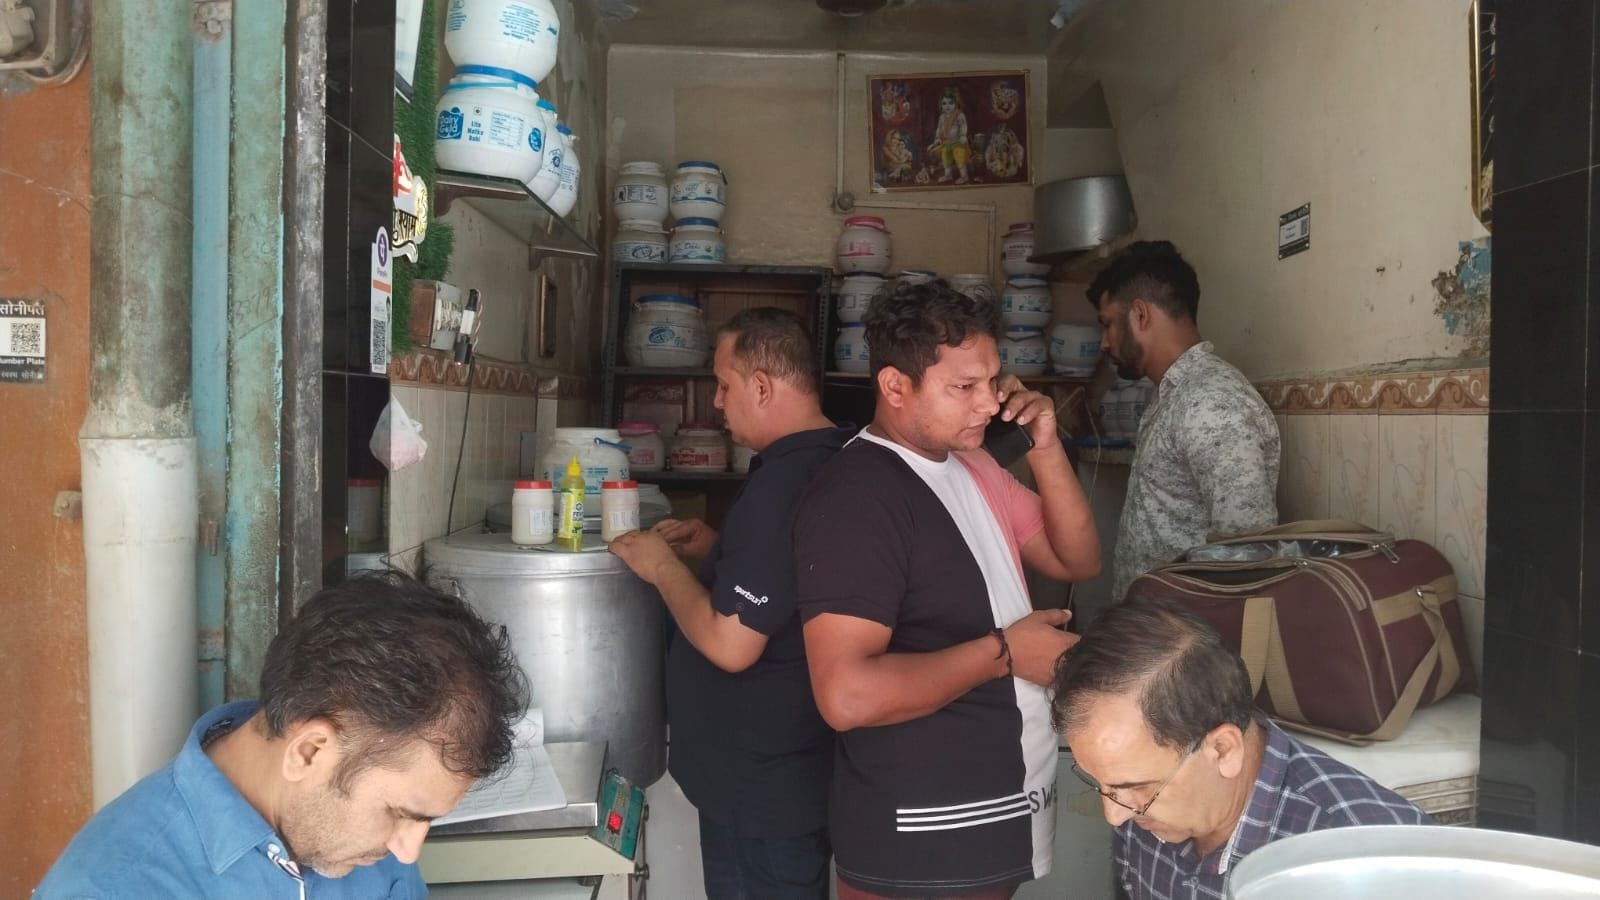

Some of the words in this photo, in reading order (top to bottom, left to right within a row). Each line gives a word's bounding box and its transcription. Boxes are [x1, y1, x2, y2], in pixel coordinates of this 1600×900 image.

[471, 120, 481, 128] Lite
[467, 127, 484, 136] Matka
[0, 357, 25, 365] umber
[1028, 783, 1056, 814] SW
